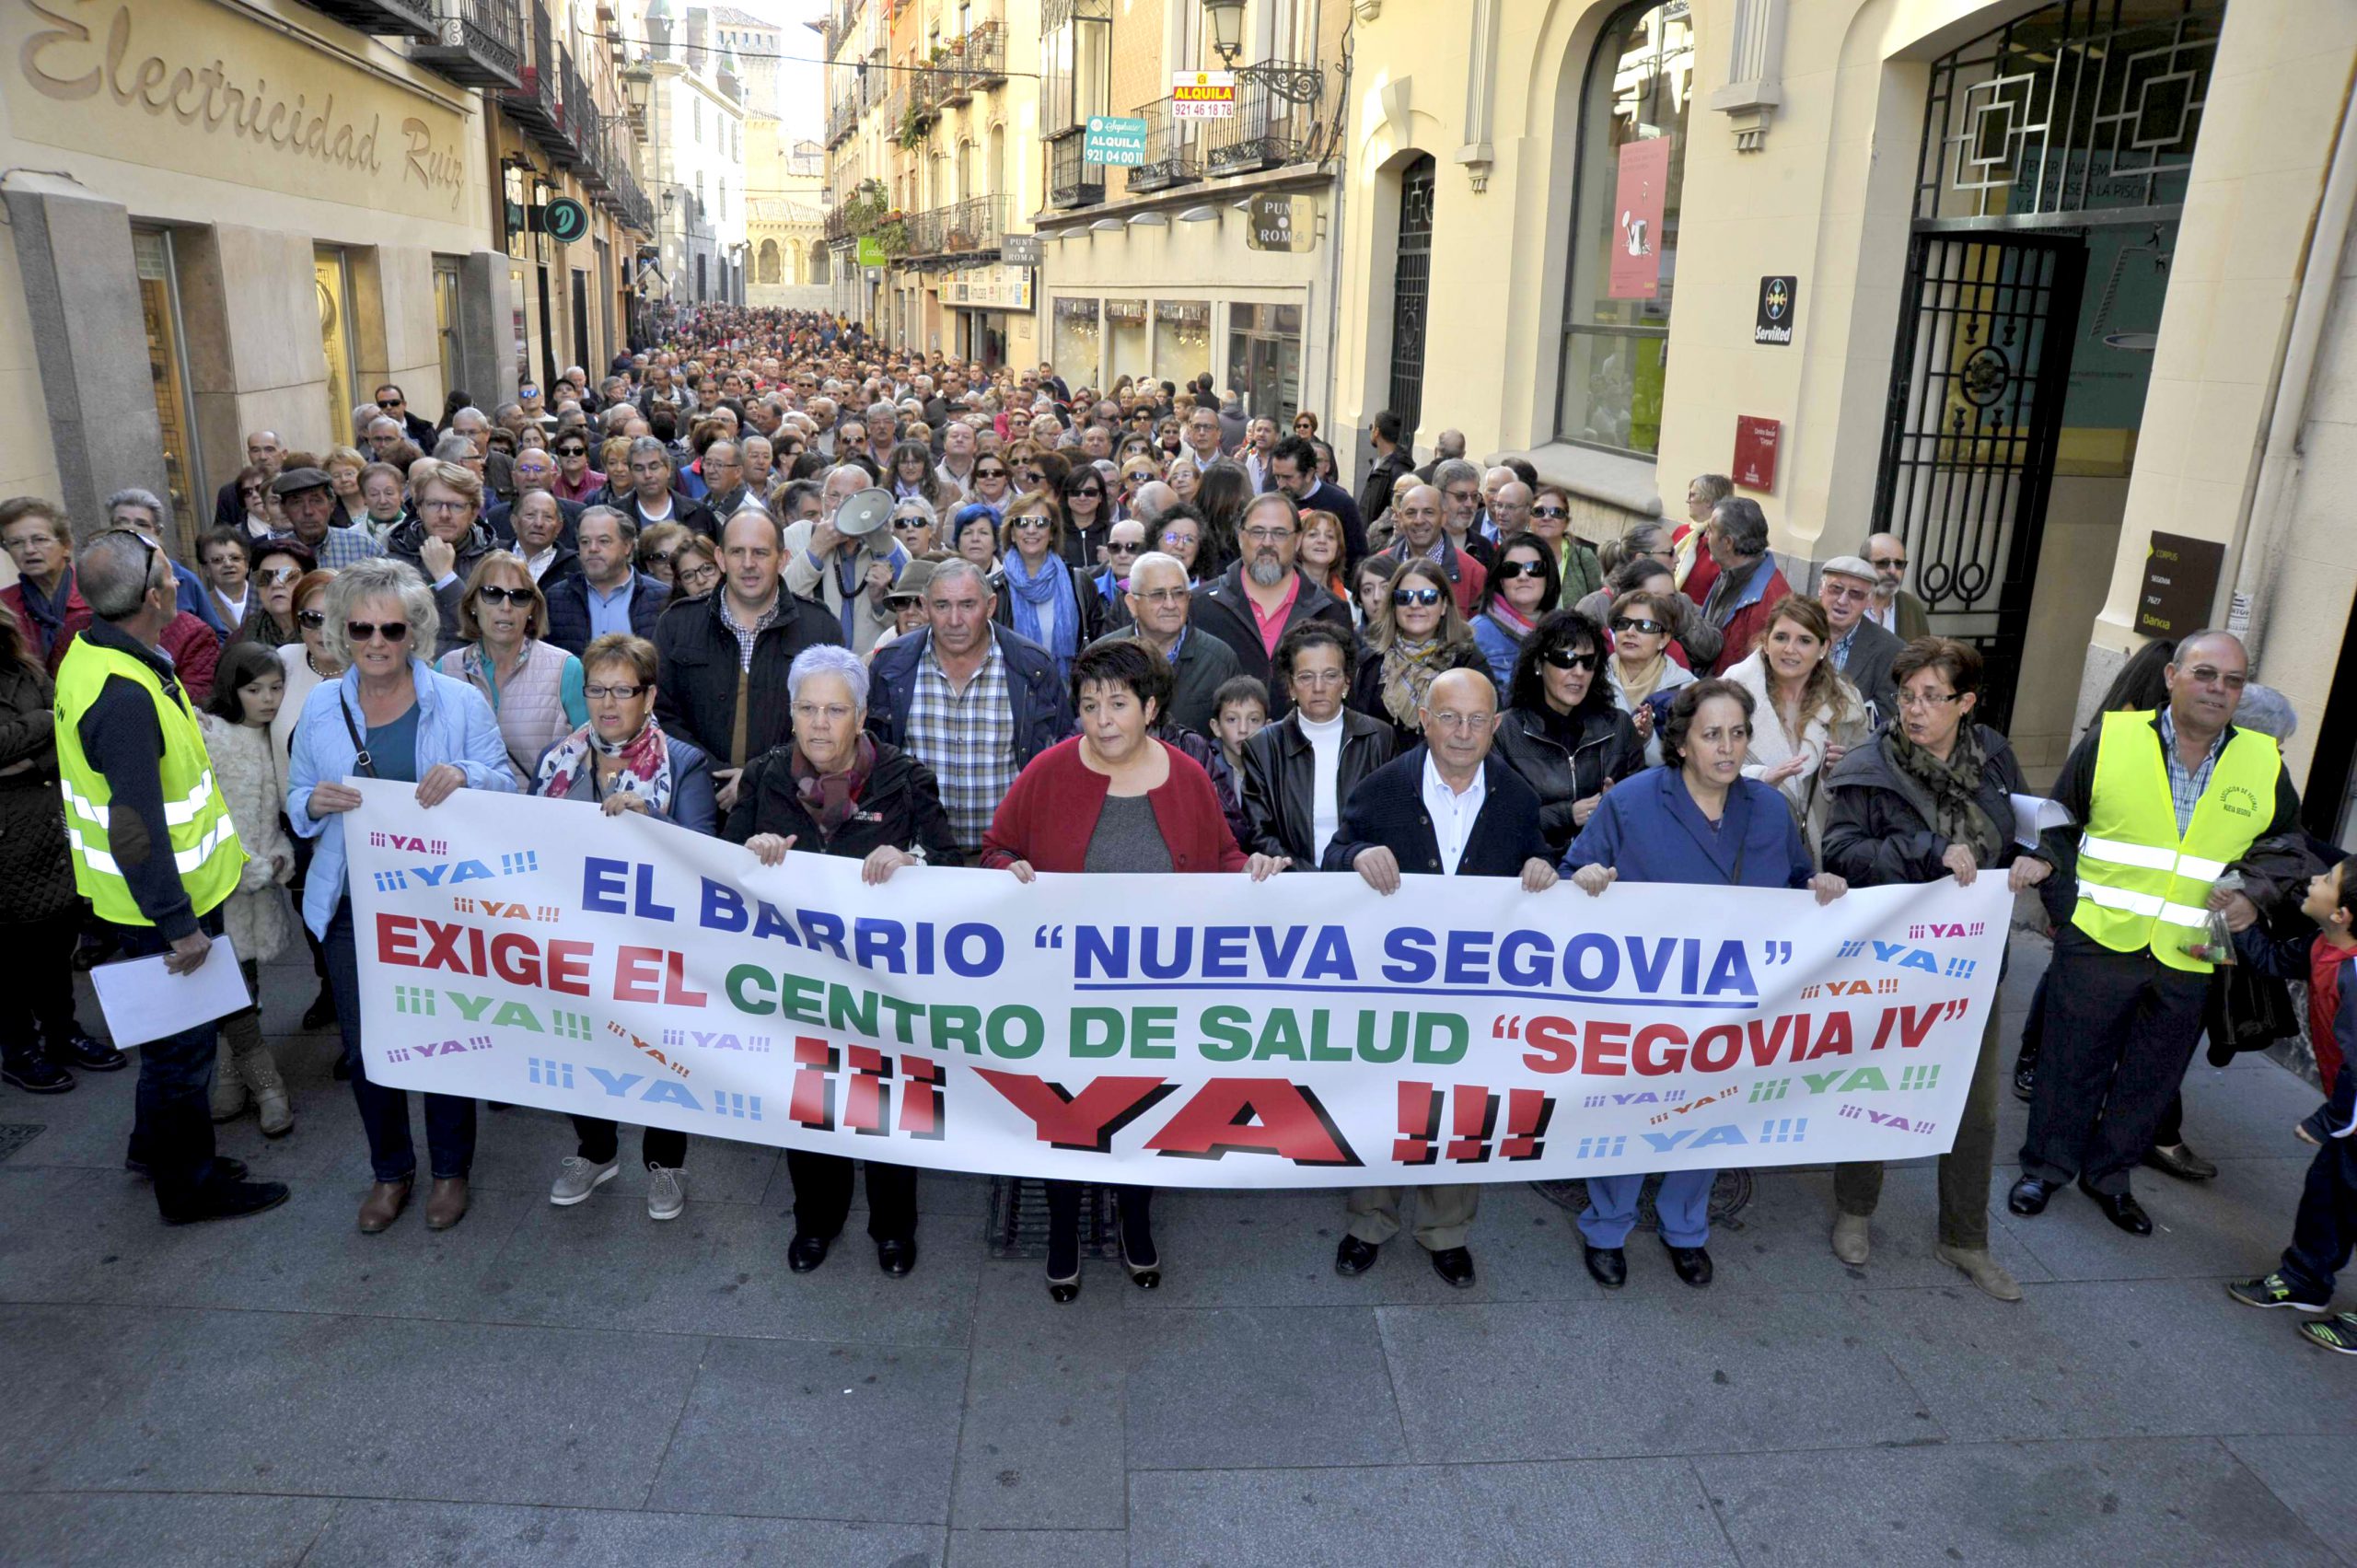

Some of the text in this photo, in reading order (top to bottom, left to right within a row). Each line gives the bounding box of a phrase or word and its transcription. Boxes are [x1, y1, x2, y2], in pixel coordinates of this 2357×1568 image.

[1175, 87, 1232, 100] ALQUILA
[20, 0, 463, 213] Electricidad Ruiz
[1175, 103, 1232, 116] 921 46 18 78
[1091, 135, 1141, 148] ALQUILA
[1086, 148, 1143, 164] 921 04 00 11
[1264, 202, 1304, 215] PUNT
[1009, 238, 1033, 246] PUNT
[1260, 229, 1305, 243] ROMA
[1008, 253, 1035, 261] ROMA
[1755, 324, 1792, 342] ServiRed
[2155, 549, 2179, 562] CORPUS
[2151, 575, 2171, 586] SEGOVIA
[2147, 595, 2161, 605] 7627
[2142, 613, 2171, 630] Bankia
[582, 856, 1793, 996] EL BARRIO “NUEVA SEGOVIA”
[376, 912, 594, 997] EXIGE
[613, 945, 708, 1007] EL
[726, 963, 1045, 1060] CENTRO
[1069, 1006, 1178, 1060] DE
[1198, 1005, 1469, 1065] SALUD
[1492, 1011, 1853, 1076] “SEGOVIA
